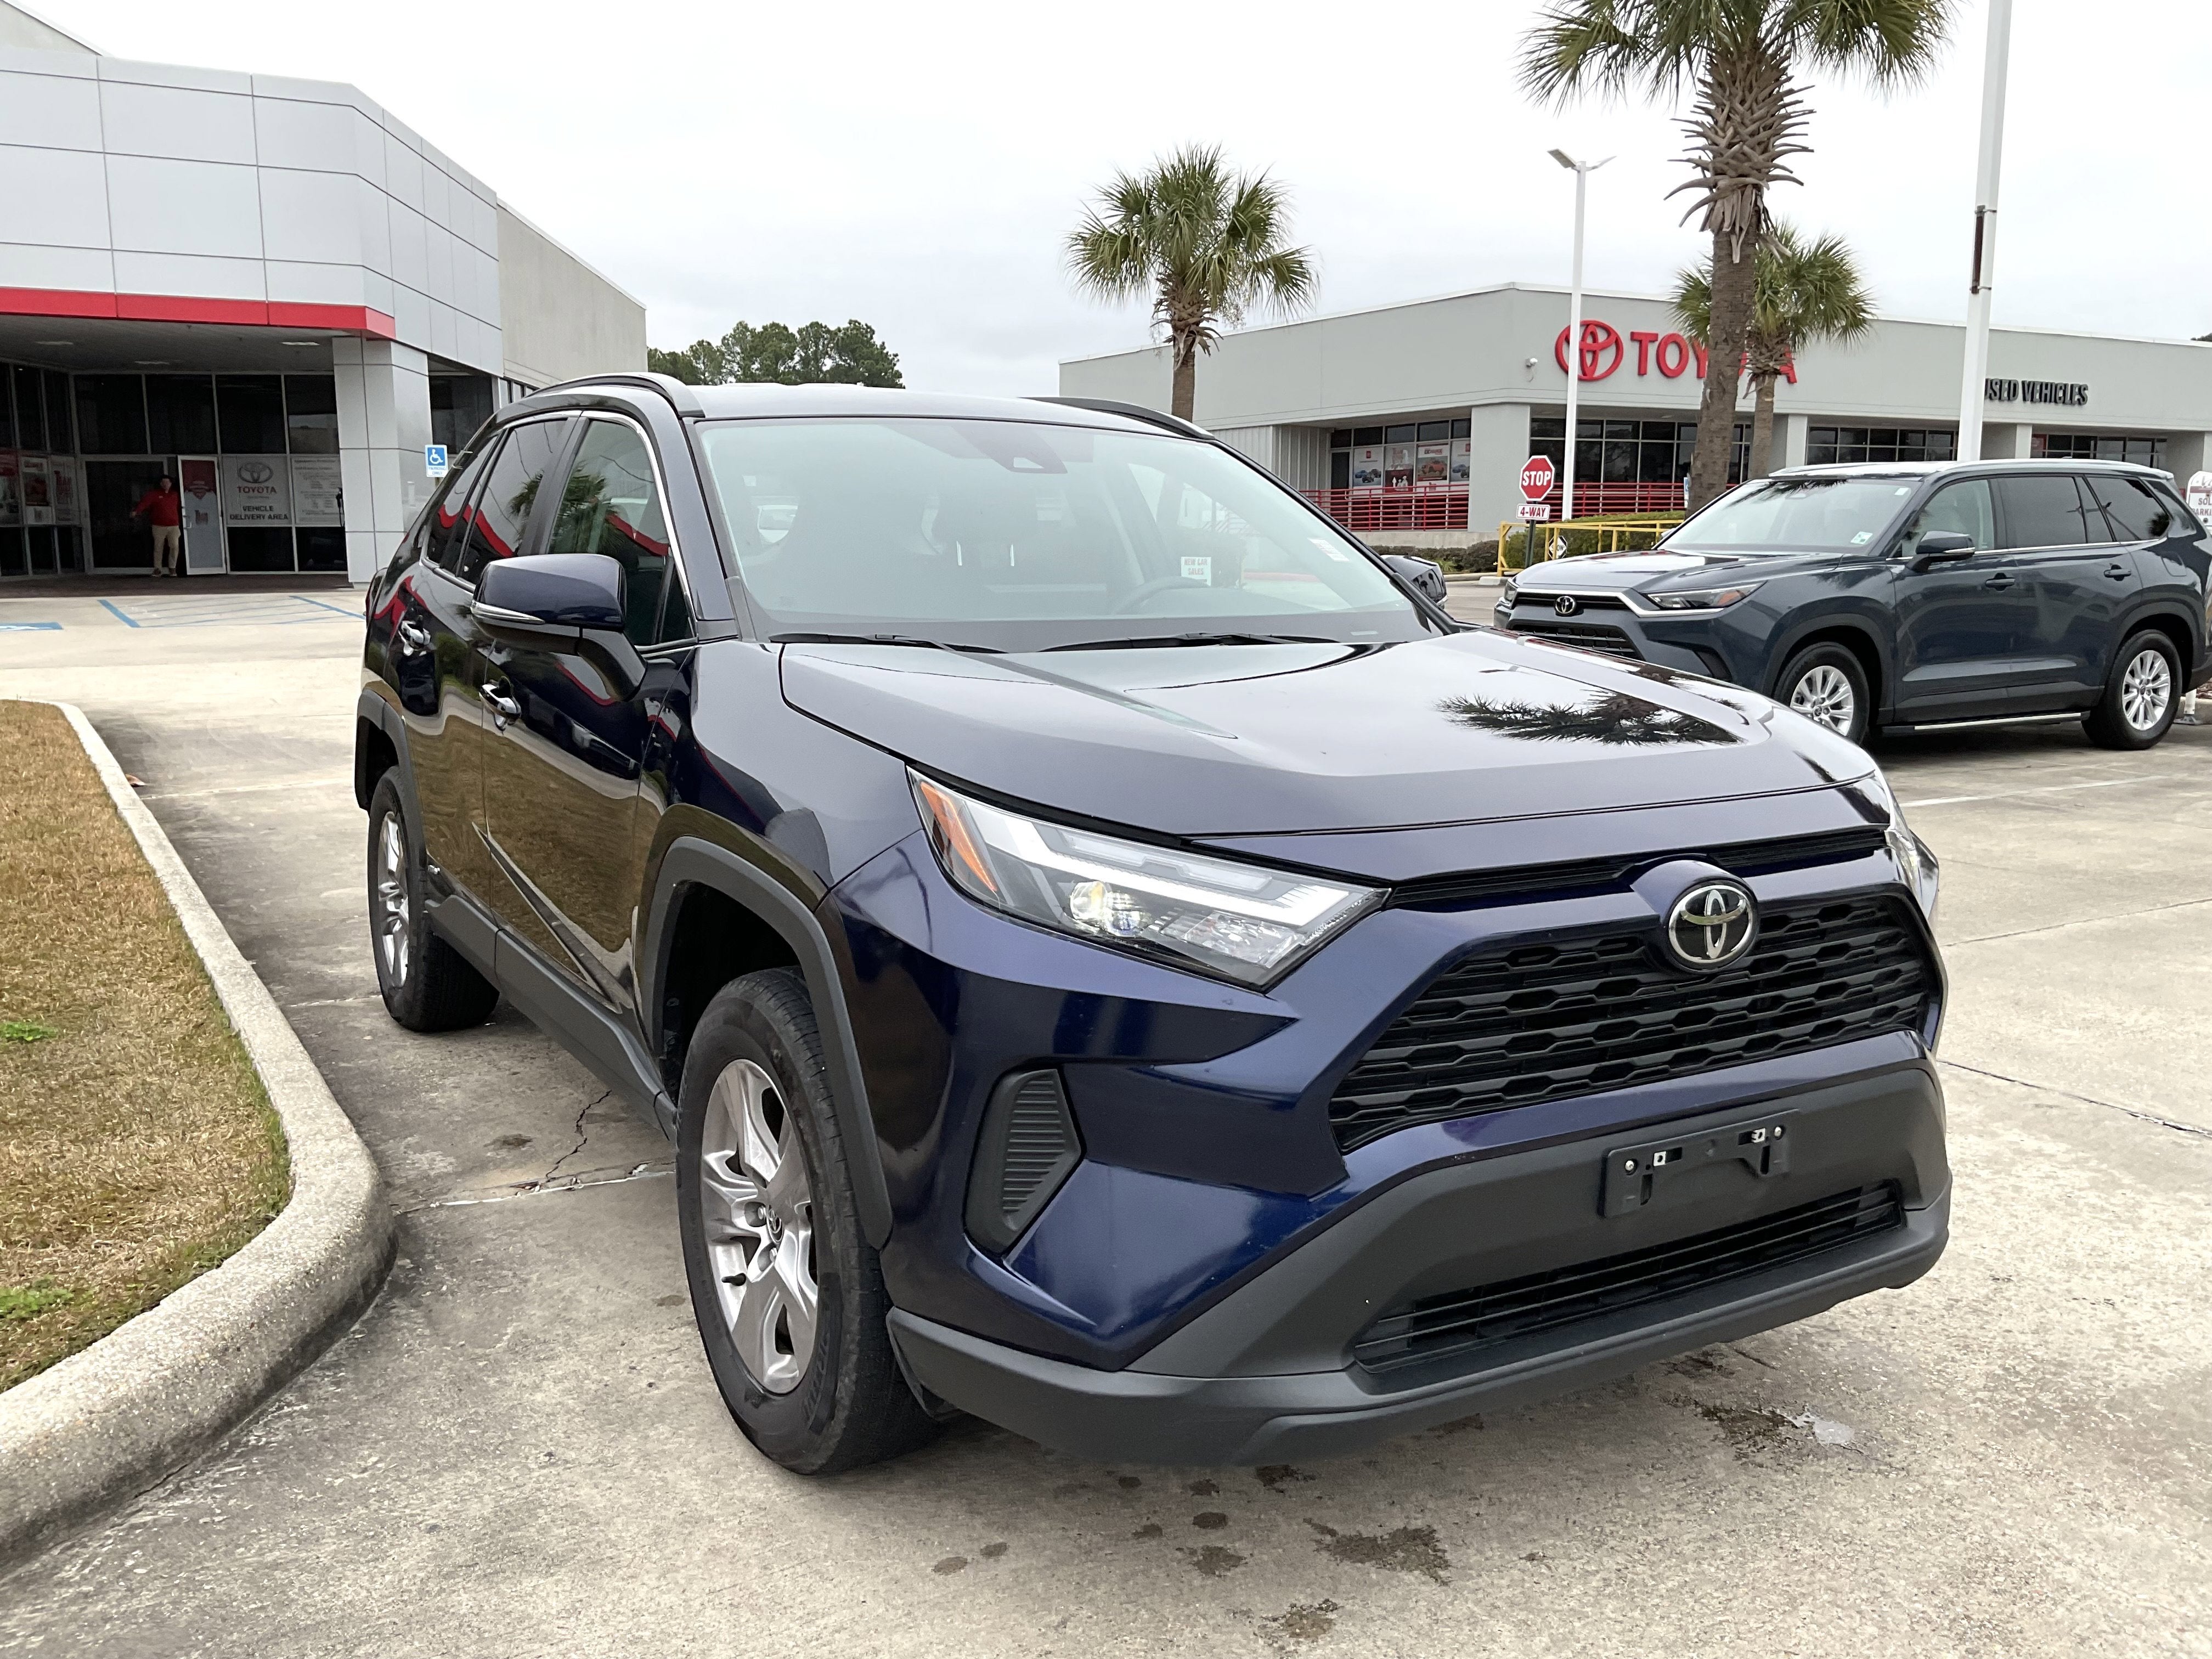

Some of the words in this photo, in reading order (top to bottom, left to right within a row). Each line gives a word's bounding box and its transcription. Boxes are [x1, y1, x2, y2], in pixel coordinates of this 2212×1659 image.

[2021, 380, 2089, 405] VEHICLES
[1522, 471, 1551, 486] STOP
[237, 486, 277, 494] TOYOTA
[1520, 506, 1546, 518] 4-WAY
